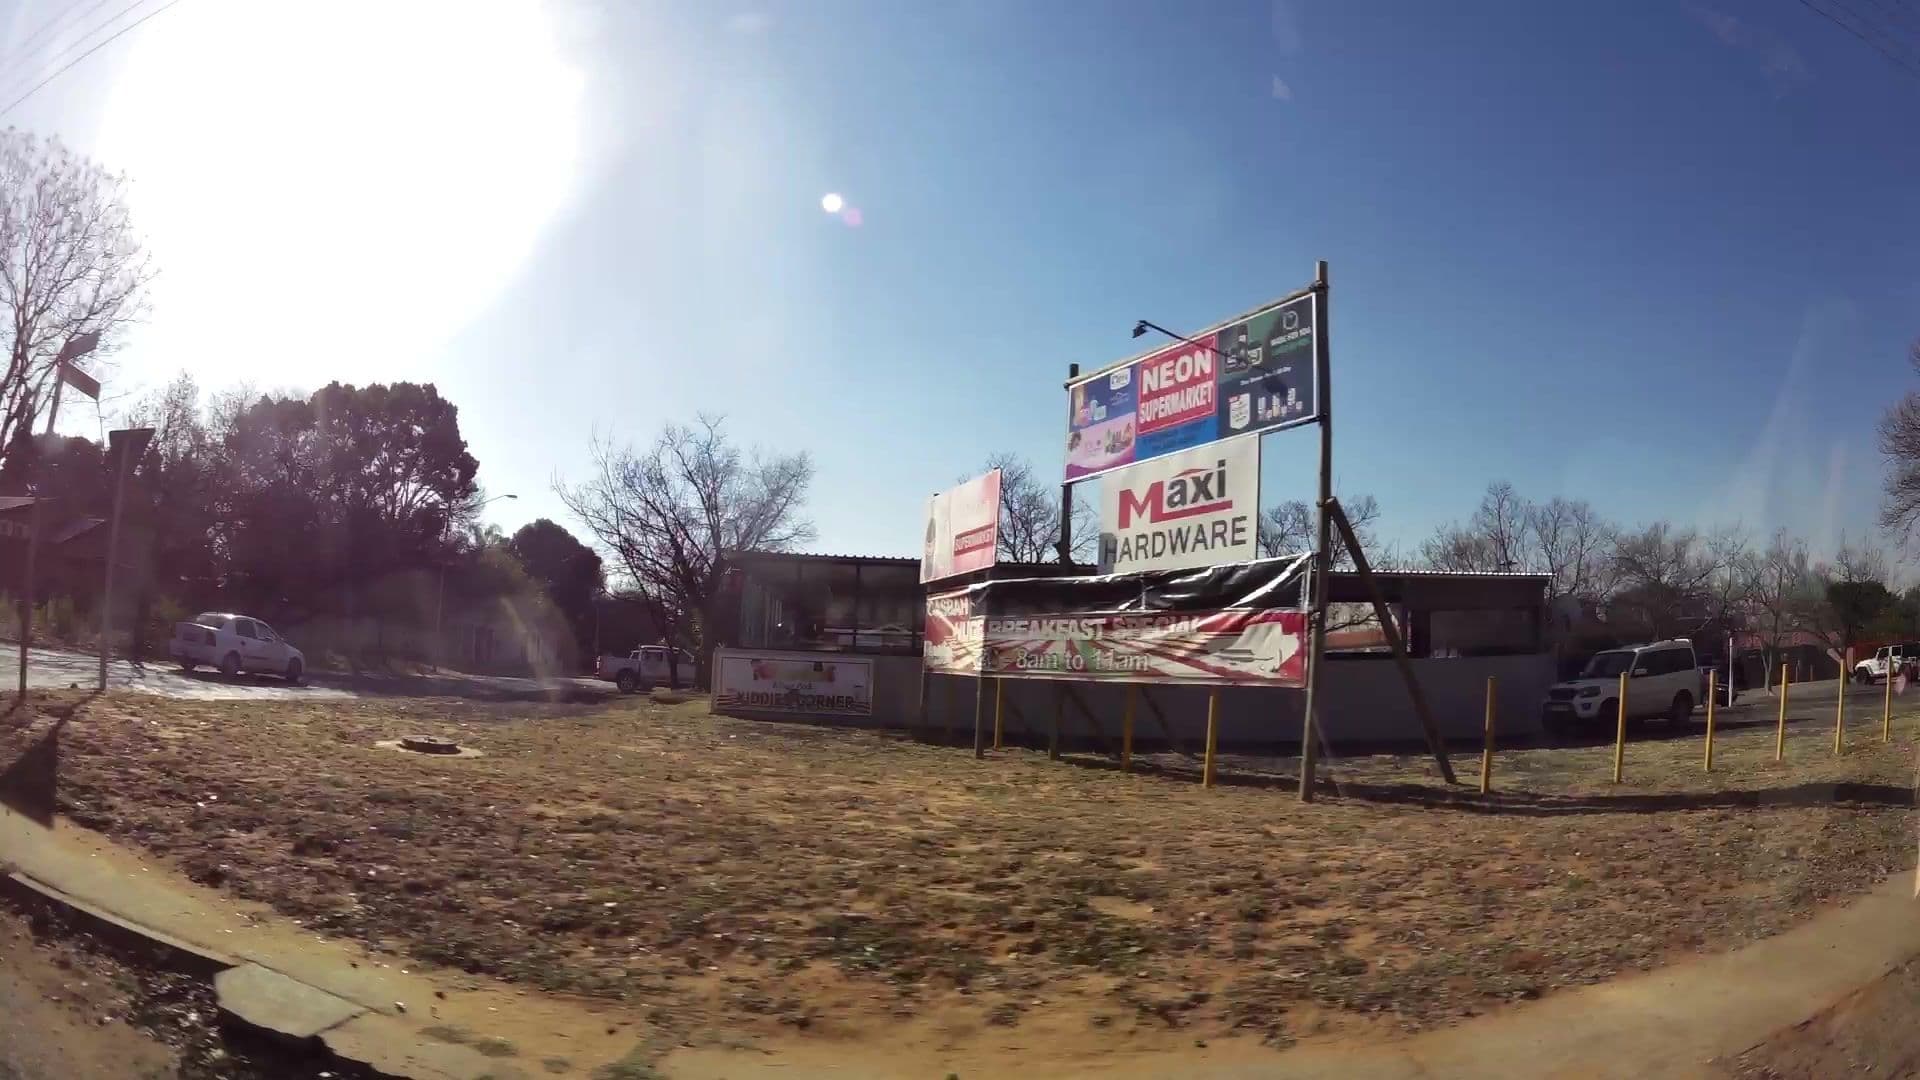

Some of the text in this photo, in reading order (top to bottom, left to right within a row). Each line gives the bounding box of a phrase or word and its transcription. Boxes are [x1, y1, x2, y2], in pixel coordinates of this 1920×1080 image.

[1142, 349, 1212, 394] NEON
[1140, 380, 1213, 424] SUPERMARKET
[1118, 459, 1226, 530] Maxi
[1103, 516, 1247, 564] HARDWARE
[988, 617, 1107, 641] BREAKFAST
[1066, 651, 1084, 670] to
